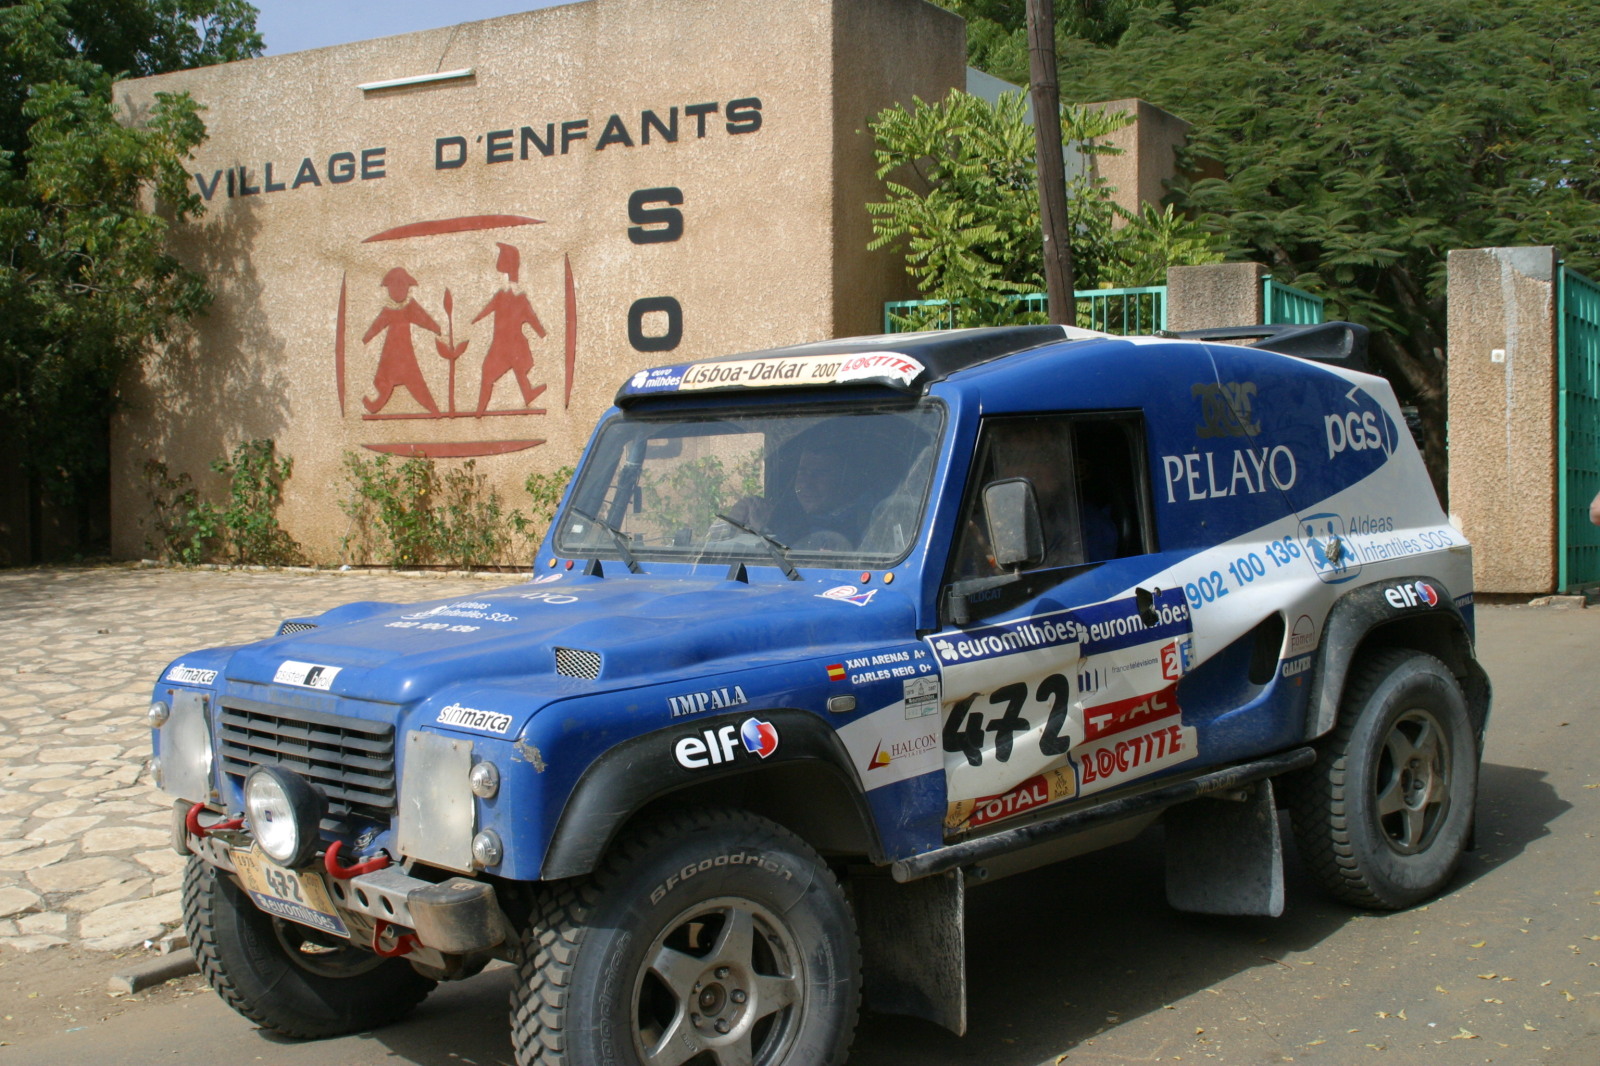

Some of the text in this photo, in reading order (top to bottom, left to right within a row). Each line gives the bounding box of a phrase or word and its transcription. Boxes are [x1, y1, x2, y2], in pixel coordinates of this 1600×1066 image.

[195, 97, 763, 201] VILLAGE D'ENFANTS
[682, 360, 842, 385] Lisboa-Dakar 2007
[842, 355, 917, 374] LOCTITE
[1162, 445, 1297, 503] PELAYO
[1349, 515, 1394, 537] Aldeas
[1358, 529, 1454, 564] Infantiles SOS
[1185, 535, 1302, 610] 902 100 136
[967, 588, 1003, 604] ILDCAT
[1385, 583, 1418, 609] elf
[1090, 603, 1189, 642] euromhões
[845, 649, 926, 670] XAVI ARENAS A+
[851, 669, 891, 685] CARLES
[891, 665, 916, 678] REIG
[1165, 652, 1179, 678] 2
[438, 703, 510, 731] sinmarca
[668, 685, 748, 718] IMPALA
[942, 673, 1071, 767] 472
[675, 725, 740, 769] elf
[892, 733, 937, 756] HALCON
[1081, 724, 1184, 785] LOCTITE
[976, 785, 1047, 821] TOTAL
[266, 866, 304, 903] 472
[650, 851, 793, 906] BFGoodrich
